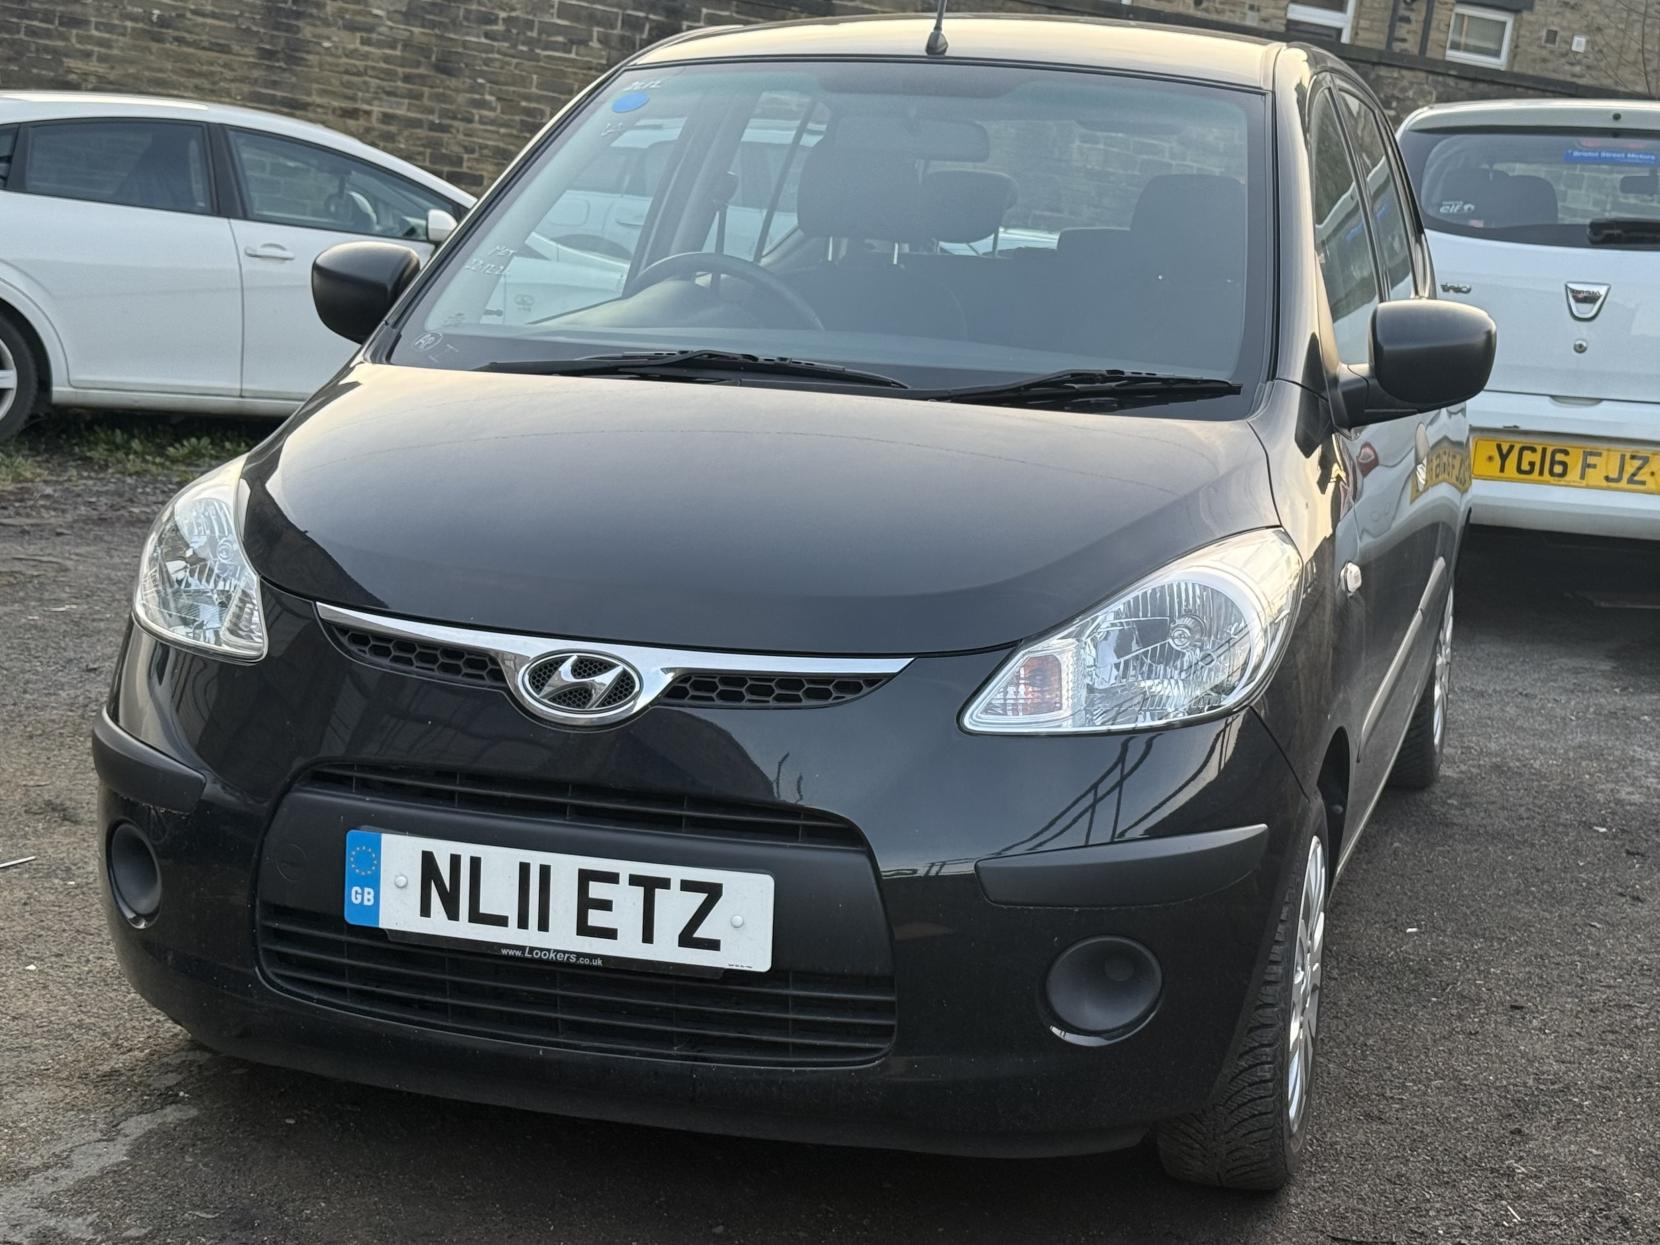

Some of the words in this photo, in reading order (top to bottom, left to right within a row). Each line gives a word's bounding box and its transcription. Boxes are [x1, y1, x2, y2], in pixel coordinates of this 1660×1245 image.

[1496, 443, 1570, 479] YG16
[1579, 450, 1650, 486] FJZ
[351, 886, 374, 906] GB
[419, 850, 552, 933] NL11
[576, 868, 724, 952] ETZ
[501, 946, 603, 967] www.Lookers.co.uk
